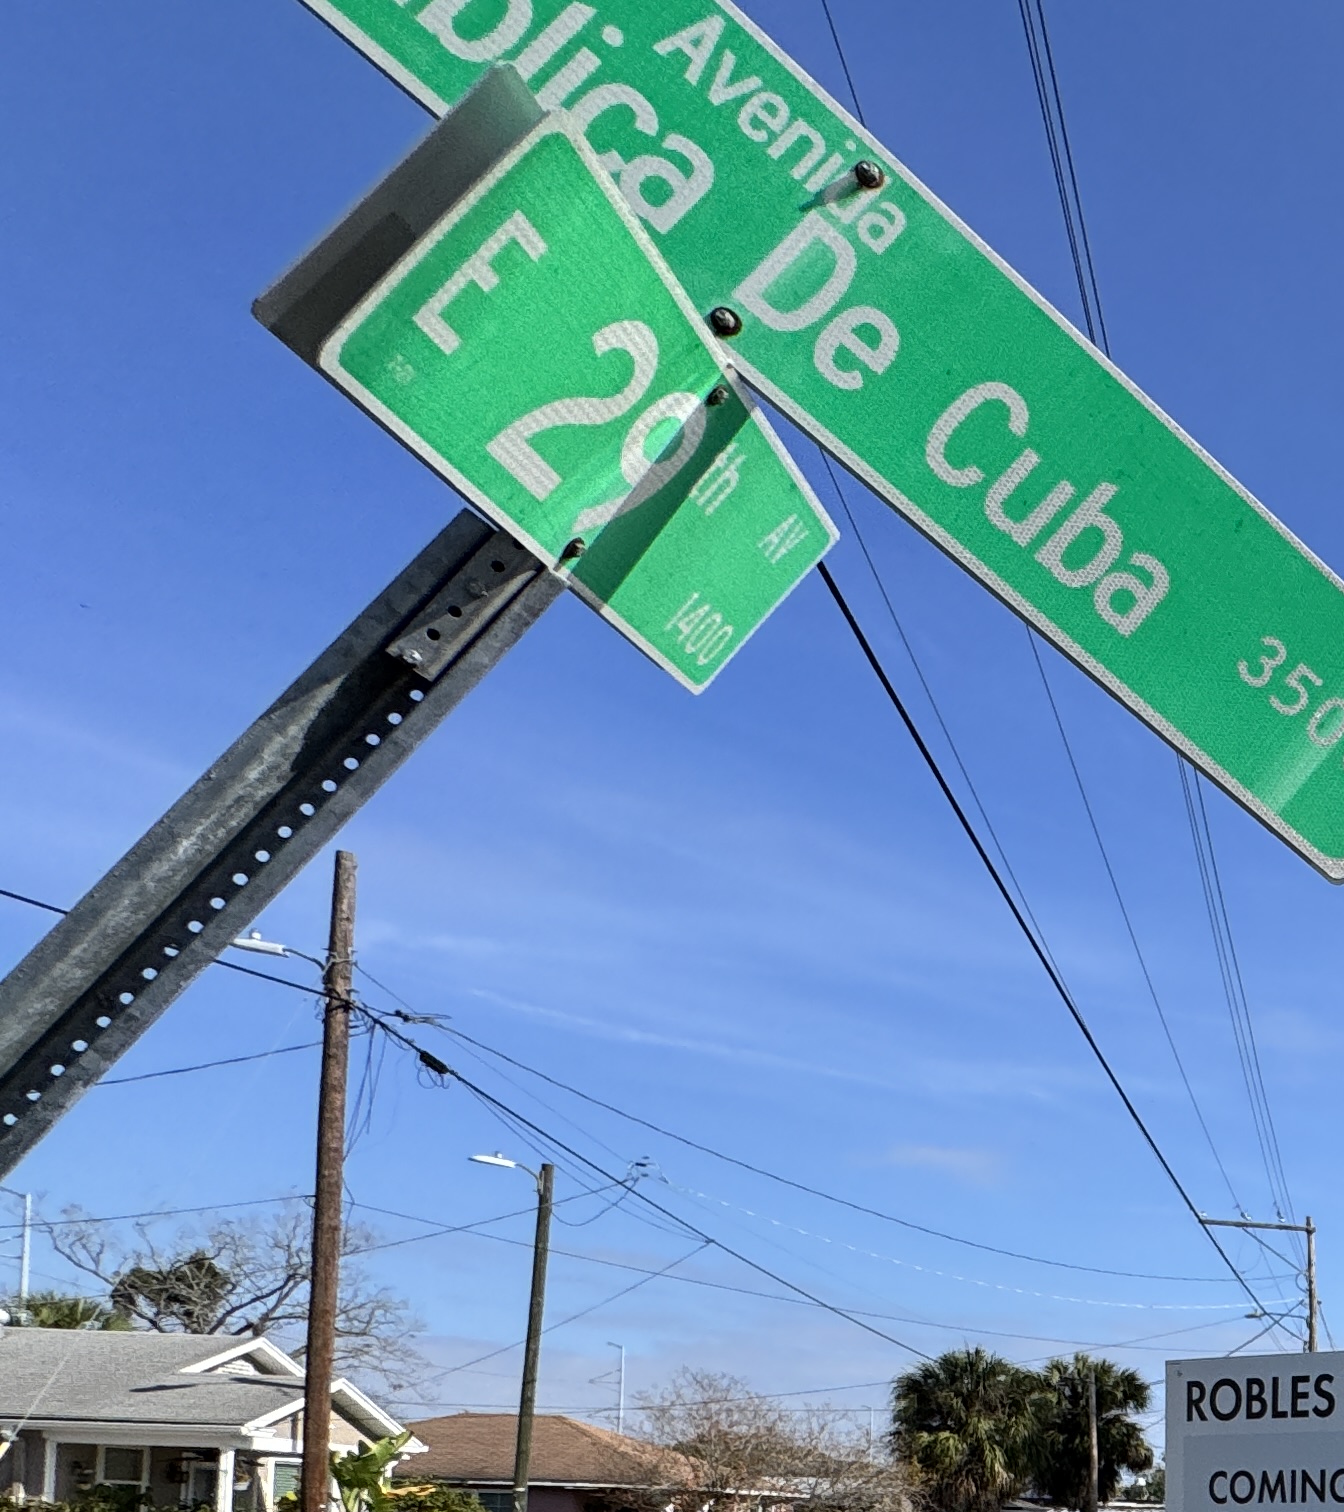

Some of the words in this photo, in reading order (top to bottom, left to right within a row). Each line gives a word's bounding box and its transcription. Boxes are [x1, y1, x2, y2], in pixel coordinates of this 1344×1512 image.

[412, 209, 549, 356] E
[757, 513, 809, 565] AV
[732, 209, 901, 390] De
[924, 381, 1170, 638] Cuba
[663, 592, 734, 666] 1400
[1186, 1372, 1335, 1422] ROBLES
